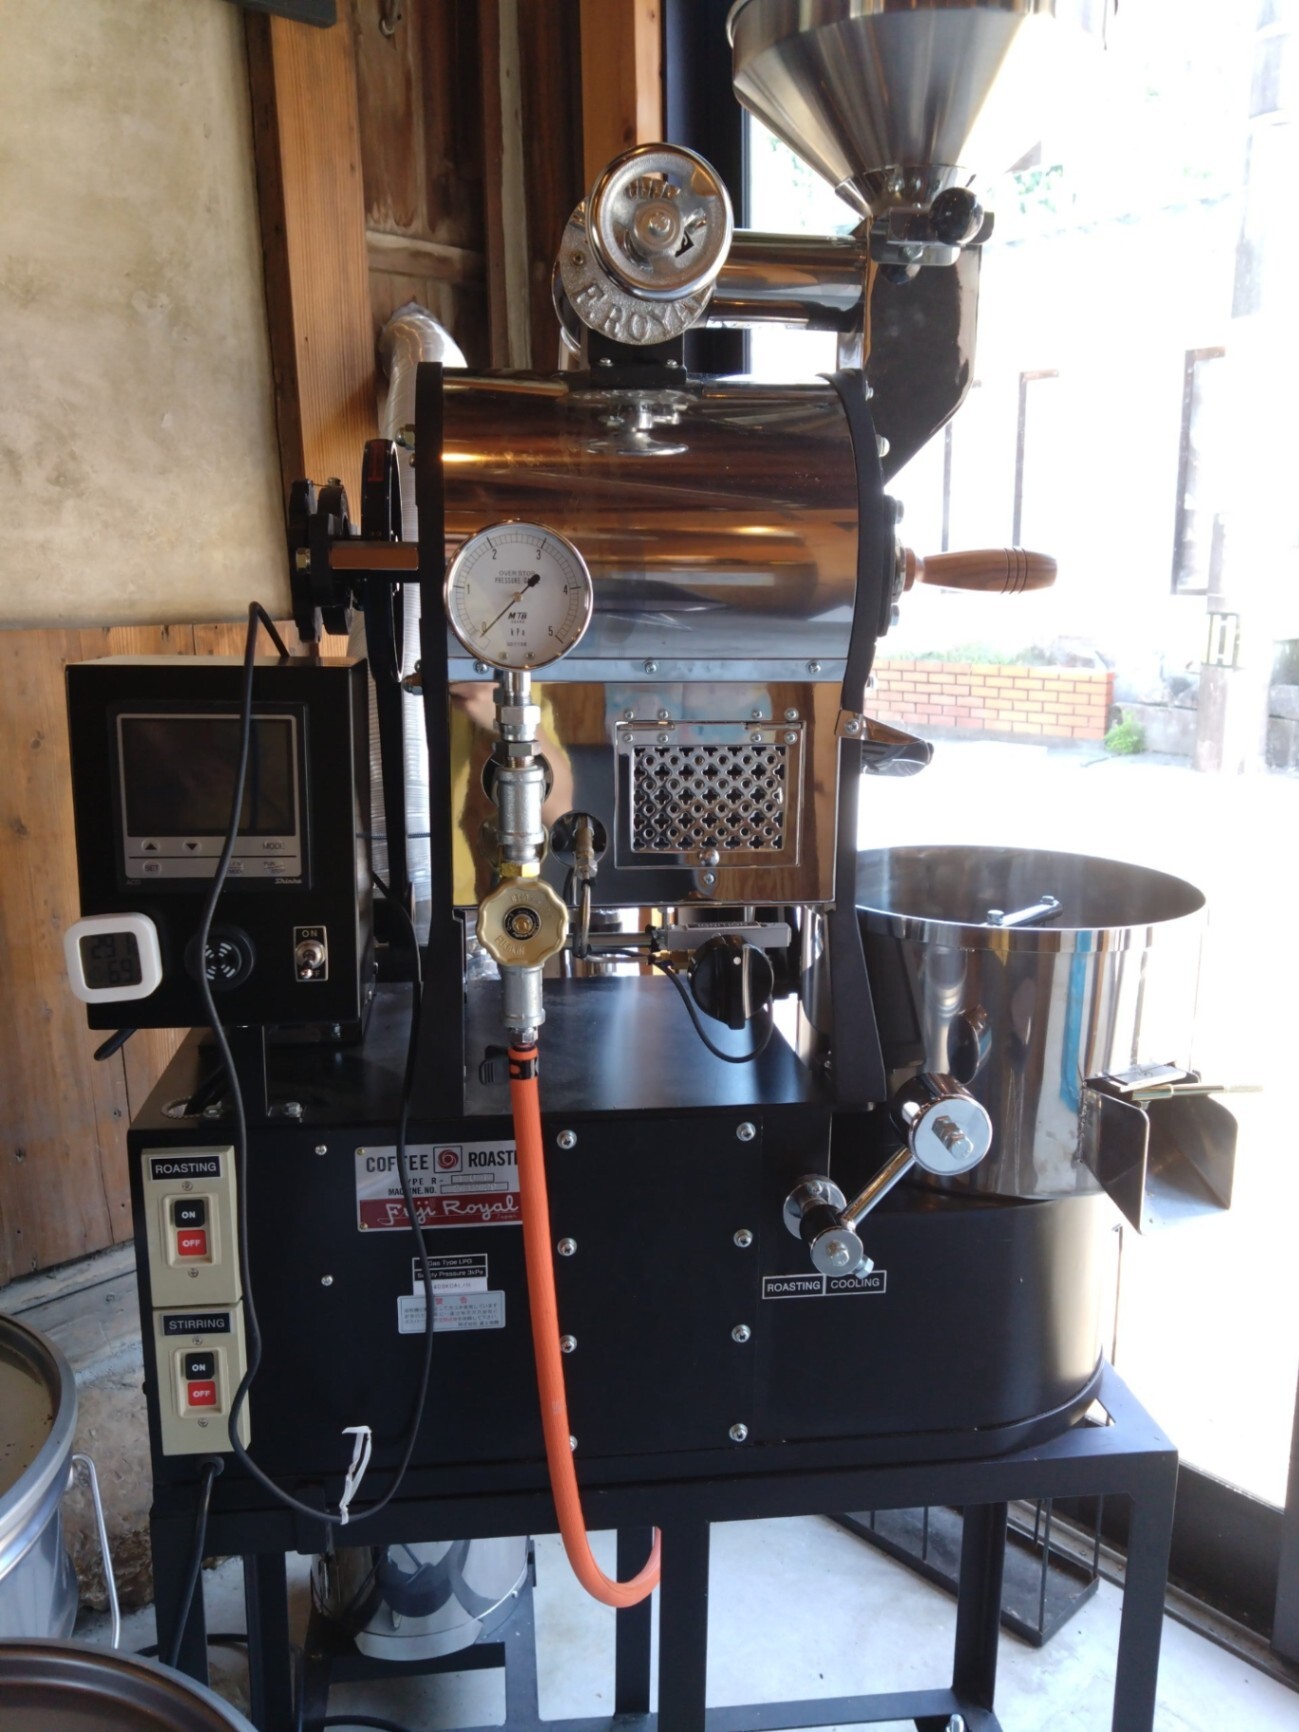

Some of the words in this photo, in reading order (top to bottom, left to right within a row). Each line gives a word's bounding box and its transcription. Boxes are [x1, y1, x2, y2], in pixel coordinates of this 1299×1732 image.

[492, 550, 497, 560] 2
[536, 550, 541, 560] 3
[466, 584, 471, 595] 1
[563, 585, 568, 595] 4
[481, 621, 487, 632] 0
[548, 626, 553, 636] 5
[144, 864, 159, 872] SET
[301, 929, 318, 938] ON
[155, 1162, 217, 1174] ROASTING
[366, 1154, 429, 1173] COFEE
[442, 1195, 519, 1220] Royal
[181, 1211, 196, 1219] ON
[182, 1239, 201, 1247] OFF
[442, 1259, 458, 1267] Type
[439, 1270, 467, 1278] Pressure
[767, 1281, 821, 1292] ROASTING
[830, 1278, 880, 1289] COOLING
[168, 1319, 225, 1330] STIRRING
[191, 1363, 206, 1372] ON
[193, 1390, 211, 1398] OFF
